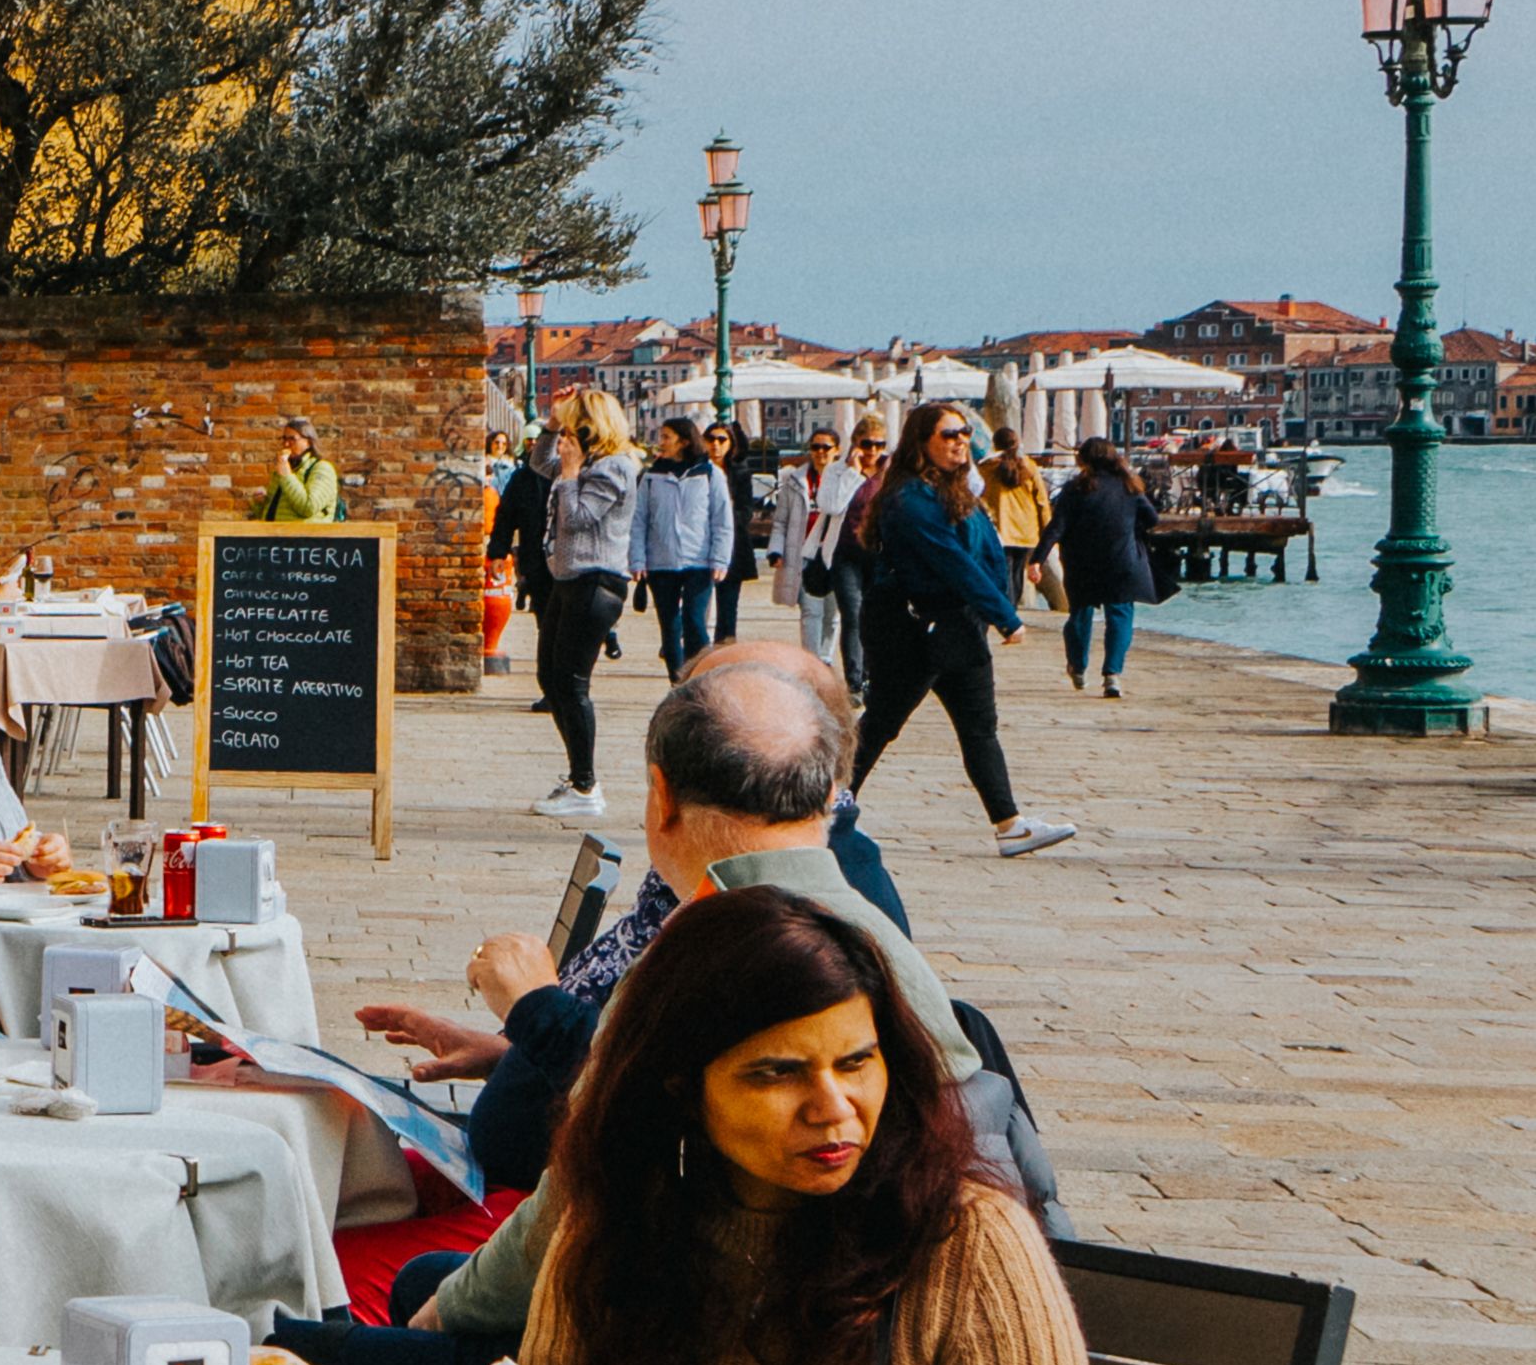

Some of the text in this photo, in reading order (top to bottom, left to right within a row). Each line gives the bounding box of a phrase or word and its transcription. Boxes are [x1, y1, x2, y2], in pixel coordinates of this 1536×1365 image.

[222, 546, 363, 568] CAFFETTERIA
[260, 655, 289, 671] TEA
[292, 680, 363, 698] APERITIVO
